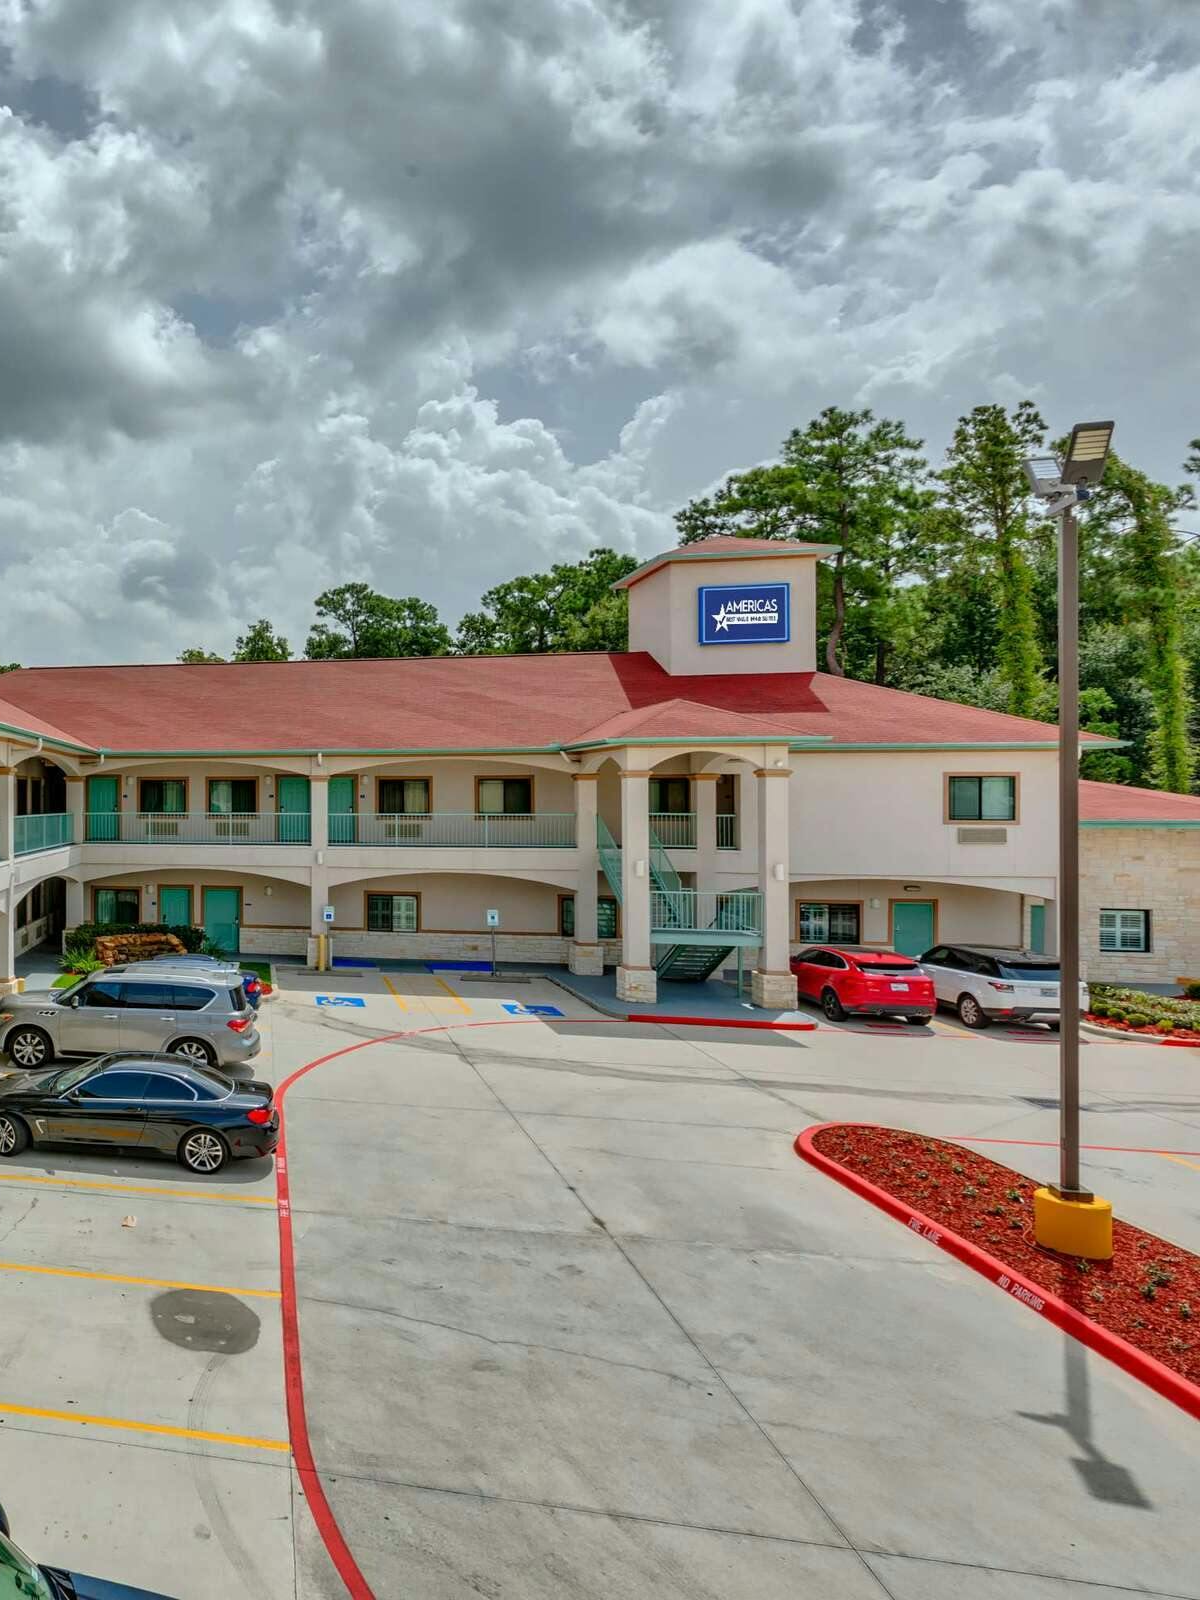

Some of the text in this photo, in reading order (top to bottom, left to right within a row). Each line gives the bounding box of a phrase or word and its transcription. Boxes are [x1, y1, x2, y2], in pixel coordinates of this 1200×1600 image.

[726, 599, 778, 612] AMERICAS
[997, 1274, 1045, 1310] NO PARKING
